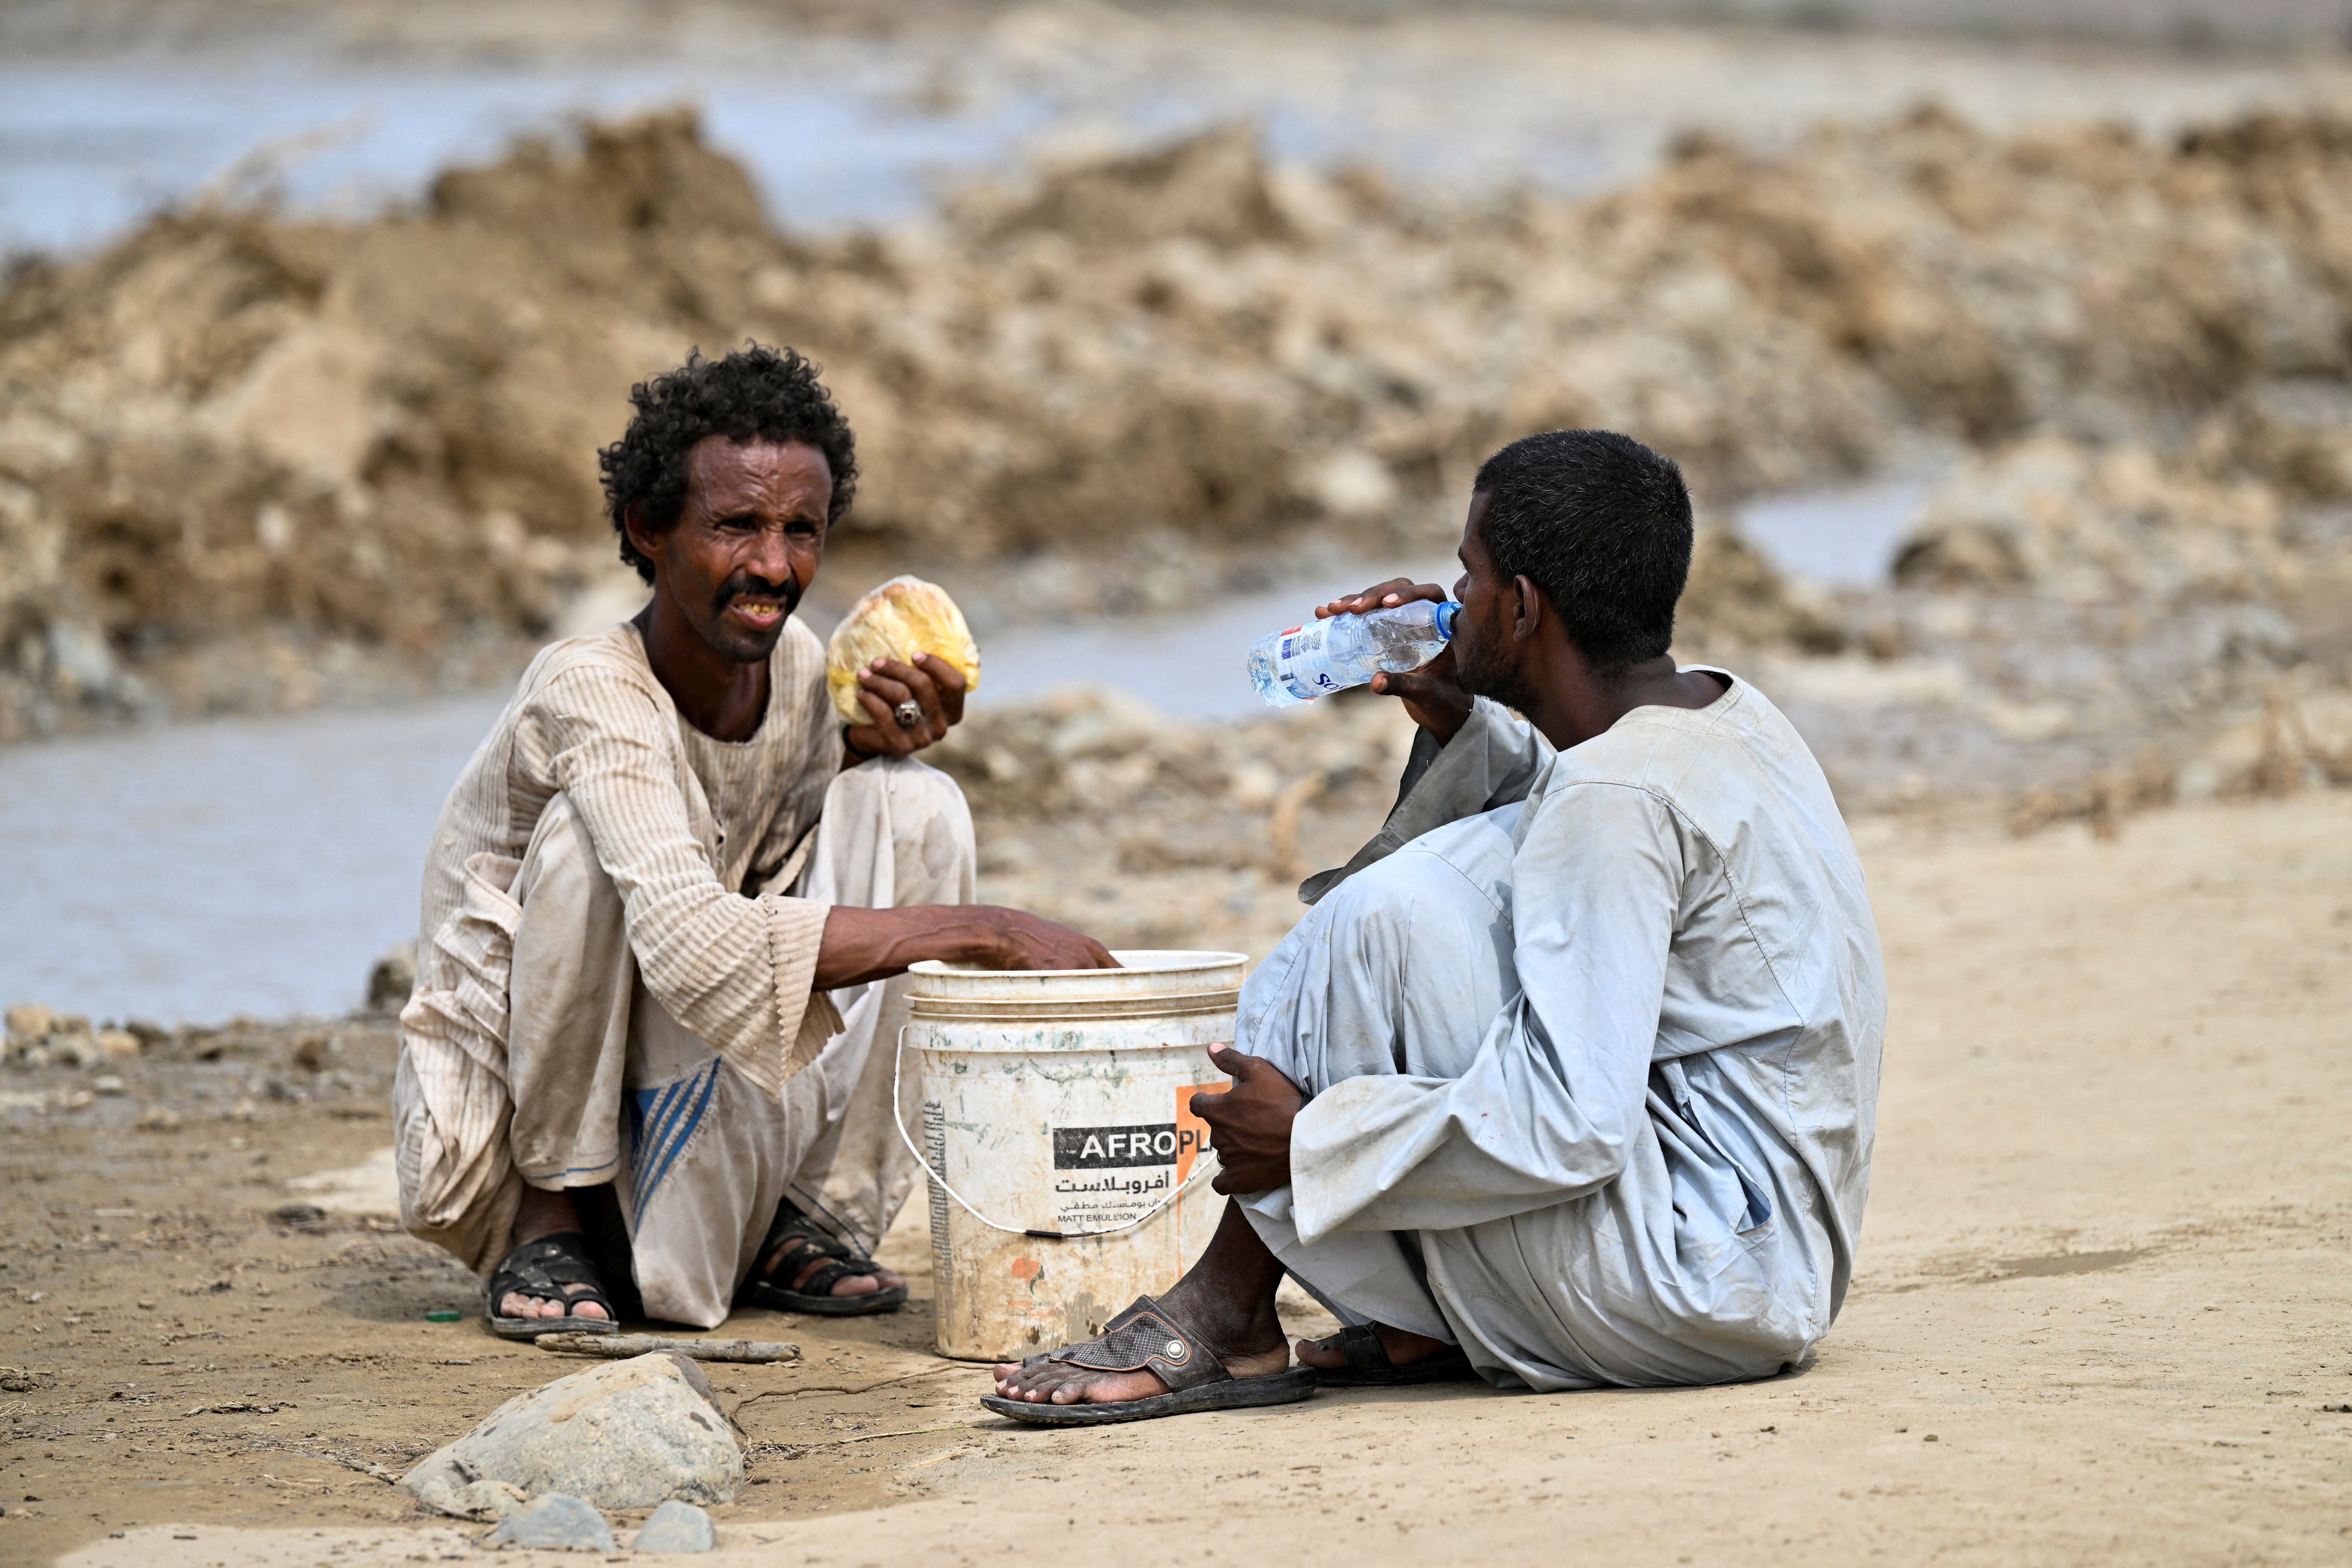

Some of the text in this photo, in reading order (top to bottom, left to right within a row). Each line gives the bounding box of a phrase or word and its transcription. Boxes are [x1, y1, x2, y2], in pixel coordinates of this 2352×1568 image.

[1080, 1129, 1212, 1159] AFROPL
[1055, 1170, 1169, 1194] أفروبلاست
[1086, 1213, 1136, 1222] EMULSION
